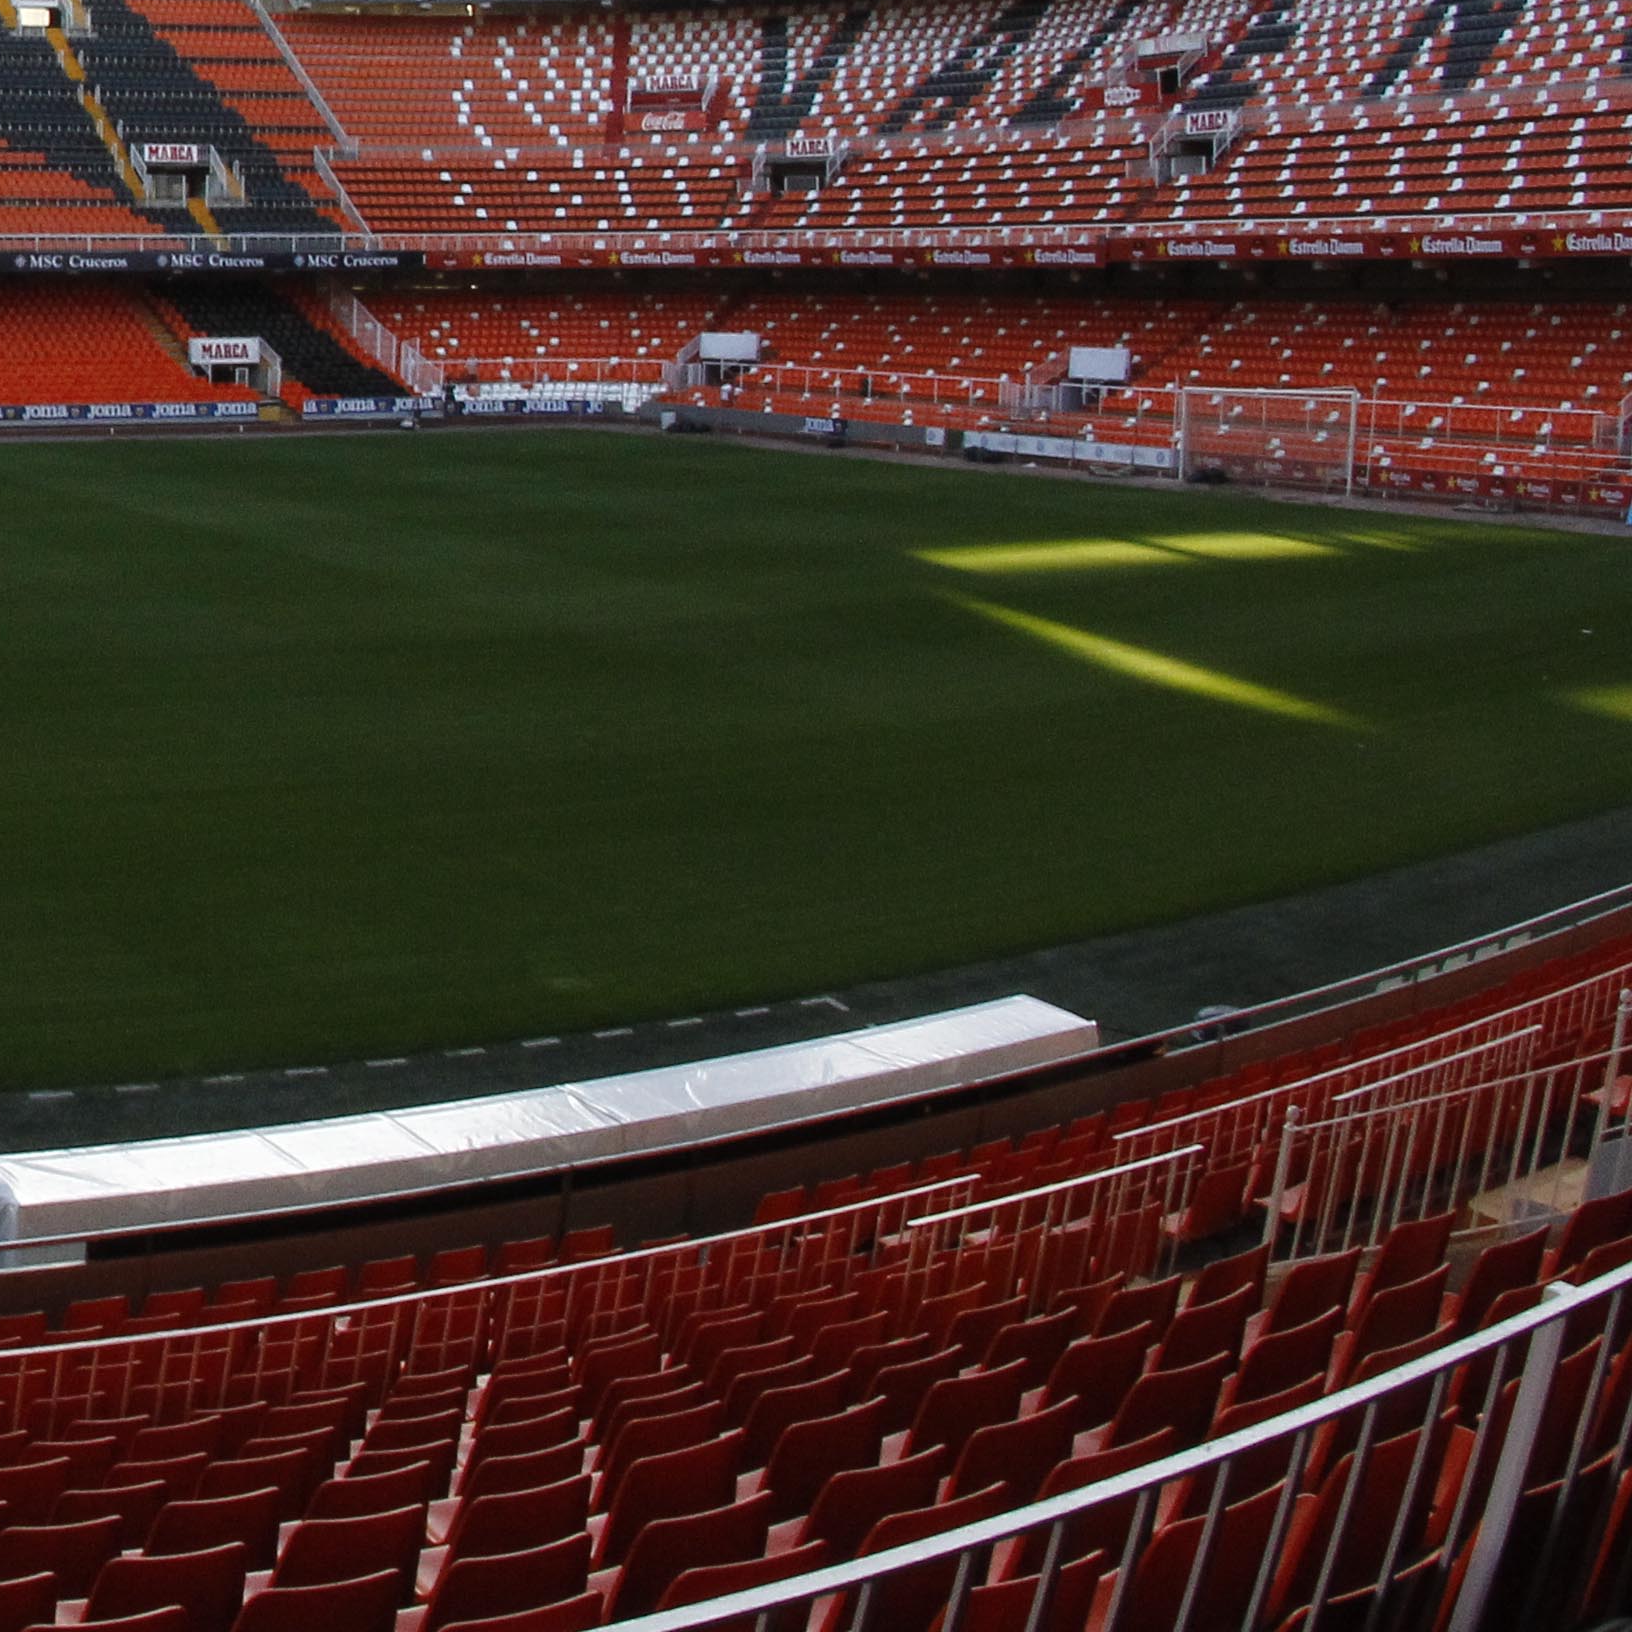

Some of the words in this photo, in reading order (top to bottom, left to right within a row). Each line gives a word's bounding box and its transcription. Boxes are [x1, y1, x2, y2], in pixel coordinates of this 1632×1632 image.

[651, 76, 692, 90] MARCA
[1190, 112, 1228, 132] MARCA
[148, 145, 193, 159] MARCA
[790, 140, 829, 155] MARCA
[1566, 232, 1613, 250] Estrella
[30, 254, 65, 268] MSC
[69, 255, 128, 268] Cruceros
[170, 254, 204, 267] MSC
[208, 254, 264, 267] Cruceros
[307, 254, 337, 267] MSC
[344, 253, 399, 267] Cruceros
[201, 343, 248, 358] MARCA
